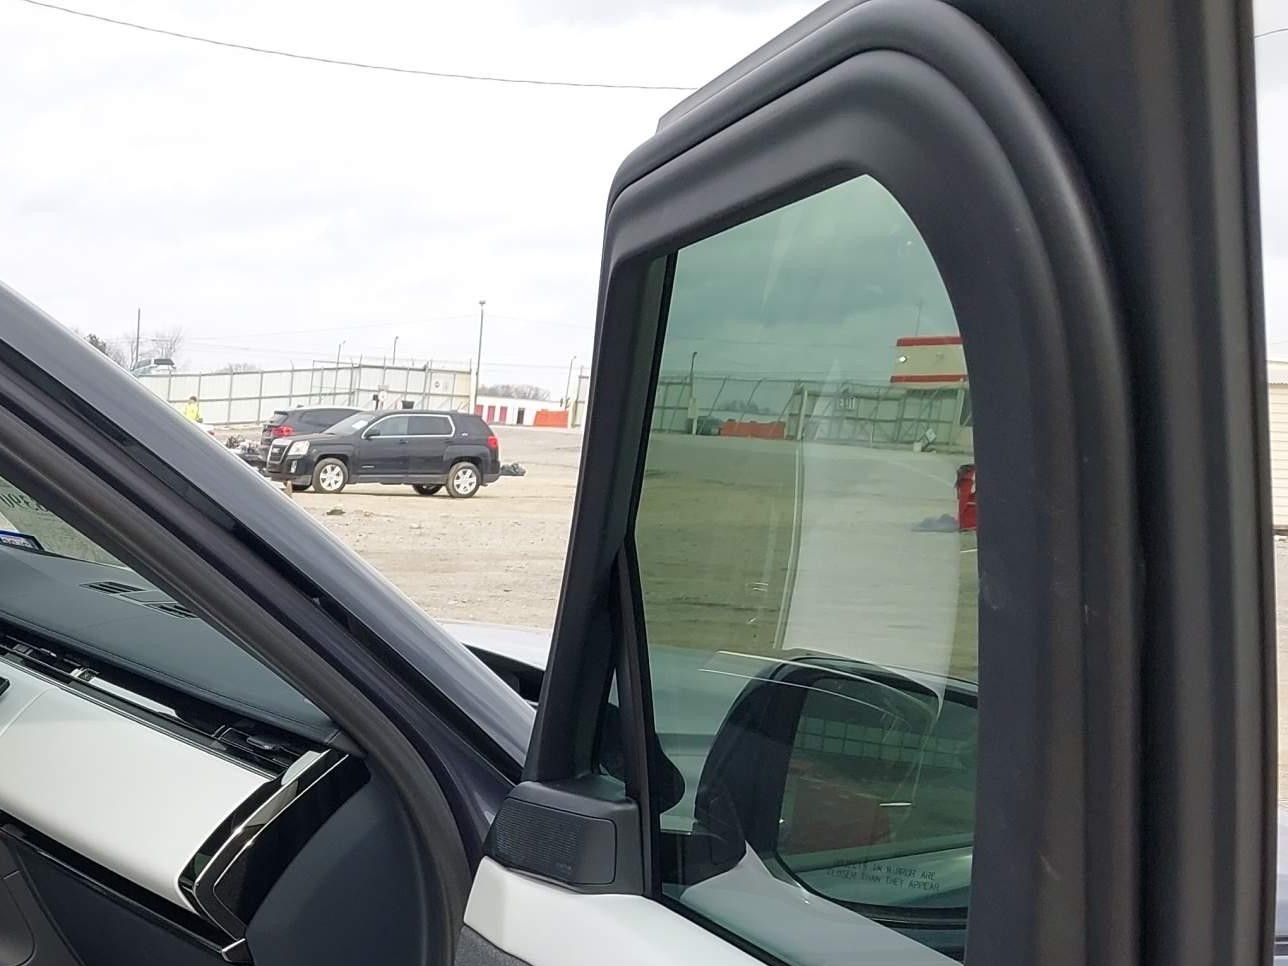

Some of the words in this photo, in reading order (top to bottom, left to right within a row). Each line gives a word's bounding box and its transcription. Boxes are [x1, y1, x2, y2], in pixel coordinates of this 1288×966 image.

[920, 871, 936, 880] ARE
[886, 875, 905, 888] THEY
[908, 879, 941, 892] APPEAR
